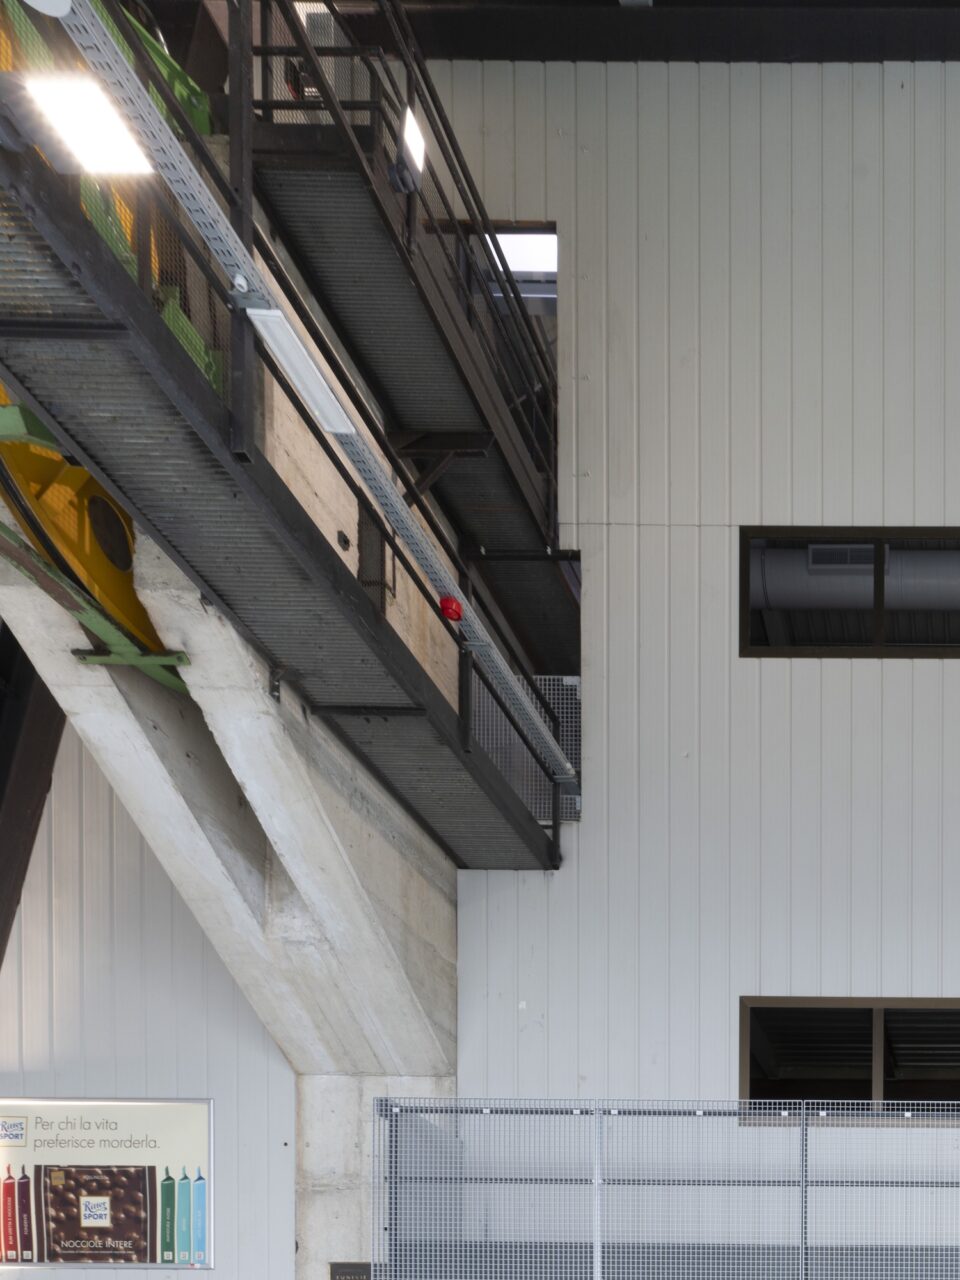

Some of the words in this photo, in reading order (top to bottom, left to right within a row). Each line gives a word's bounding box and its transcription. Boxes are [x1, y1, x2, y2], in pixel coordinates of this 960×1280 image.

[34, 1116, 55, 1130] Per
[58, 1116, 76, 1130] chi
[80, 1116, 91, 1130] la
[94, 1117, 118, 1131] vita
[34, 1134, 95, 1151] preferisce
[100, 1134, 160, 1149] morderla.
[61, 1240, 103, 1248] NOCCIOLE
[105, 1240, 133, 1249] INTERE
